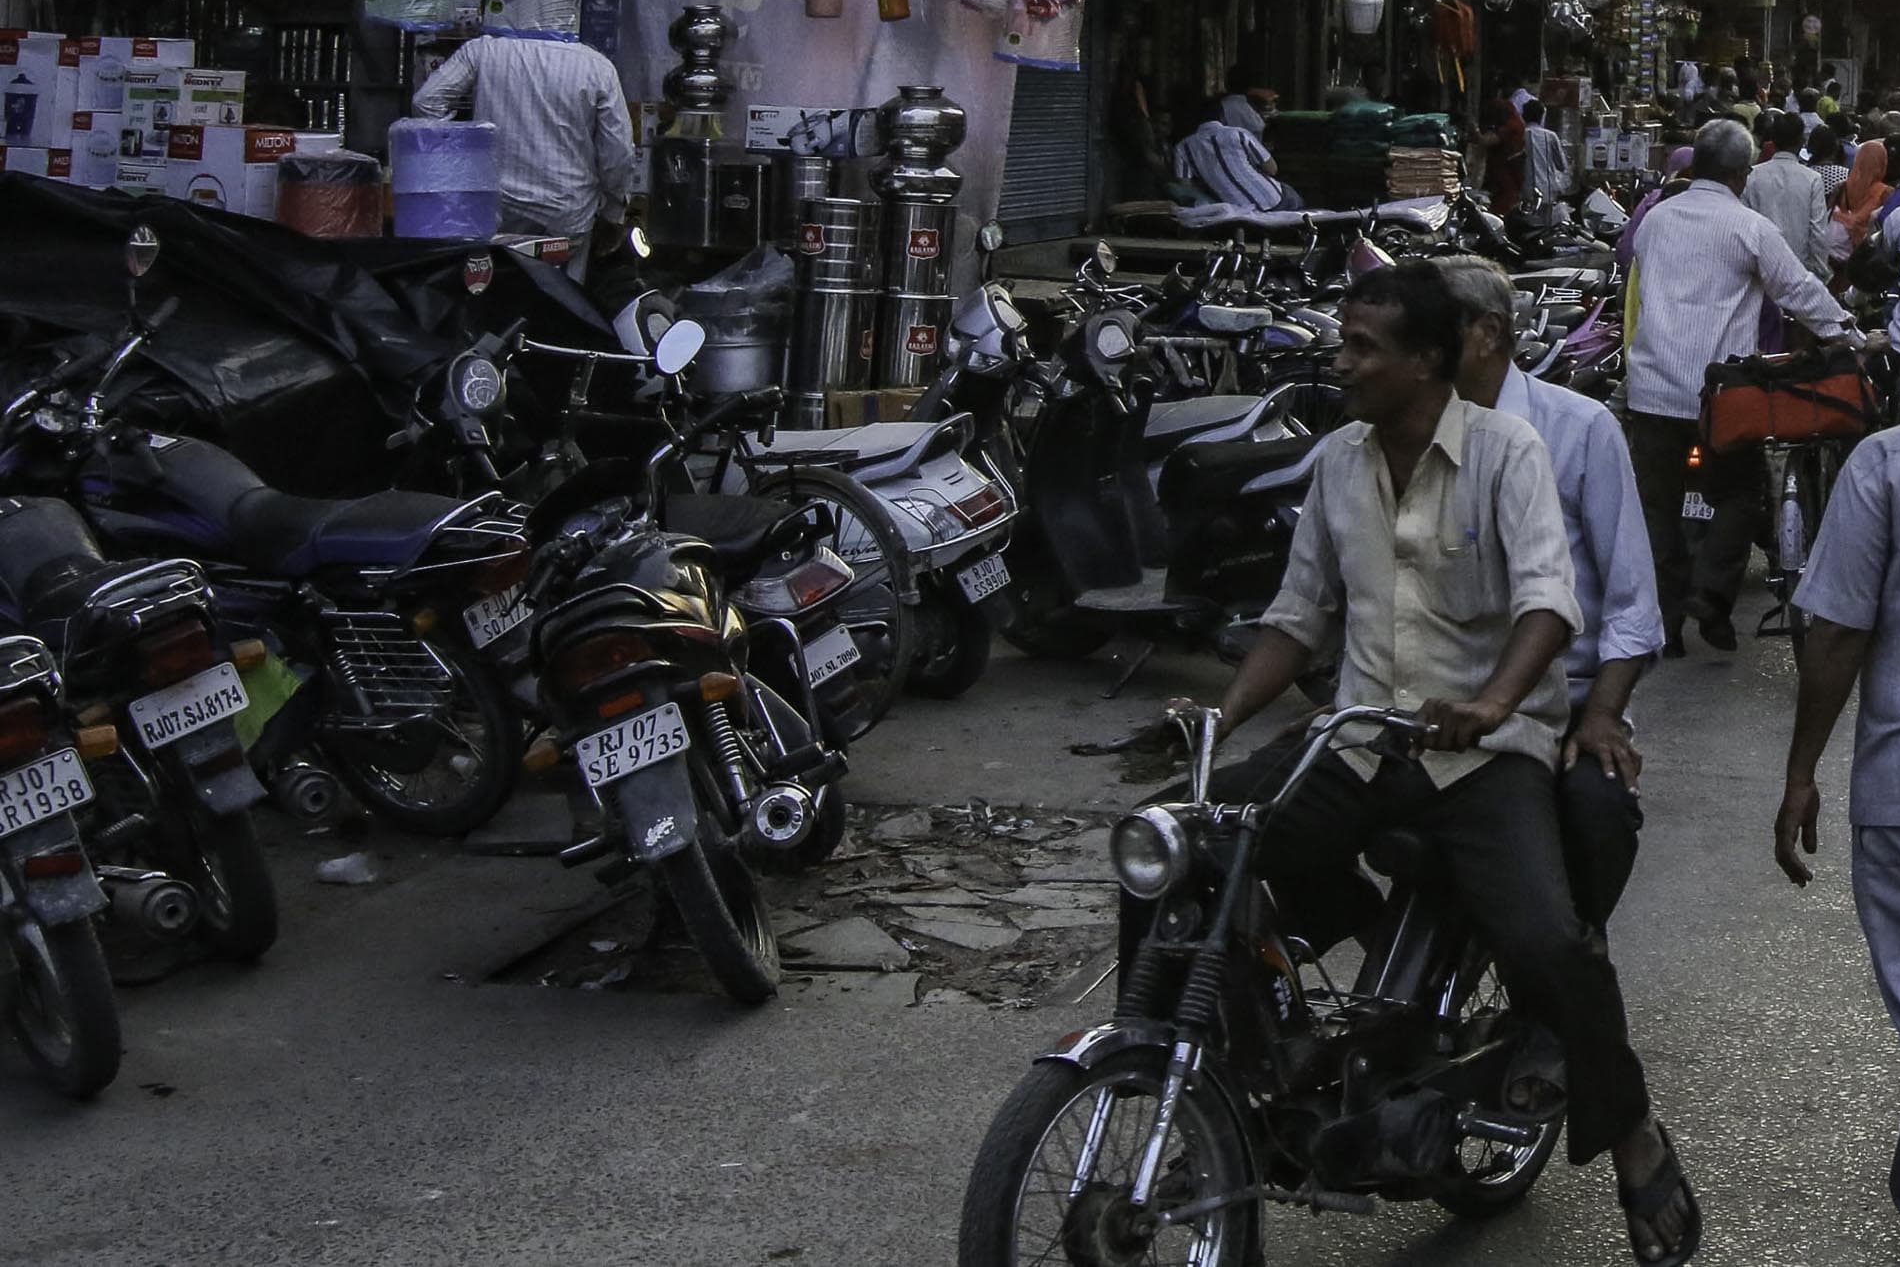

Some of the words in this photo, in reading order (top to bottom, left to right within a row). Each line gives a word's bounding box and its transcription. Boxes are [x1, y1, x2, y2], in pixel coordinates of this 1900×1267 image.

[254, 136, 291, 149] MILTON
[972, 558, 997, 580] RJ07
[974, 570, 1010, 598] SS9902
[838, 647, 858, 669] 7090
[597, 730, 626, 758] RJ
[632, 713, 658, 743] 07
[588, 752, 620, 785] SE
[628, 726, 685, 767] 9735
